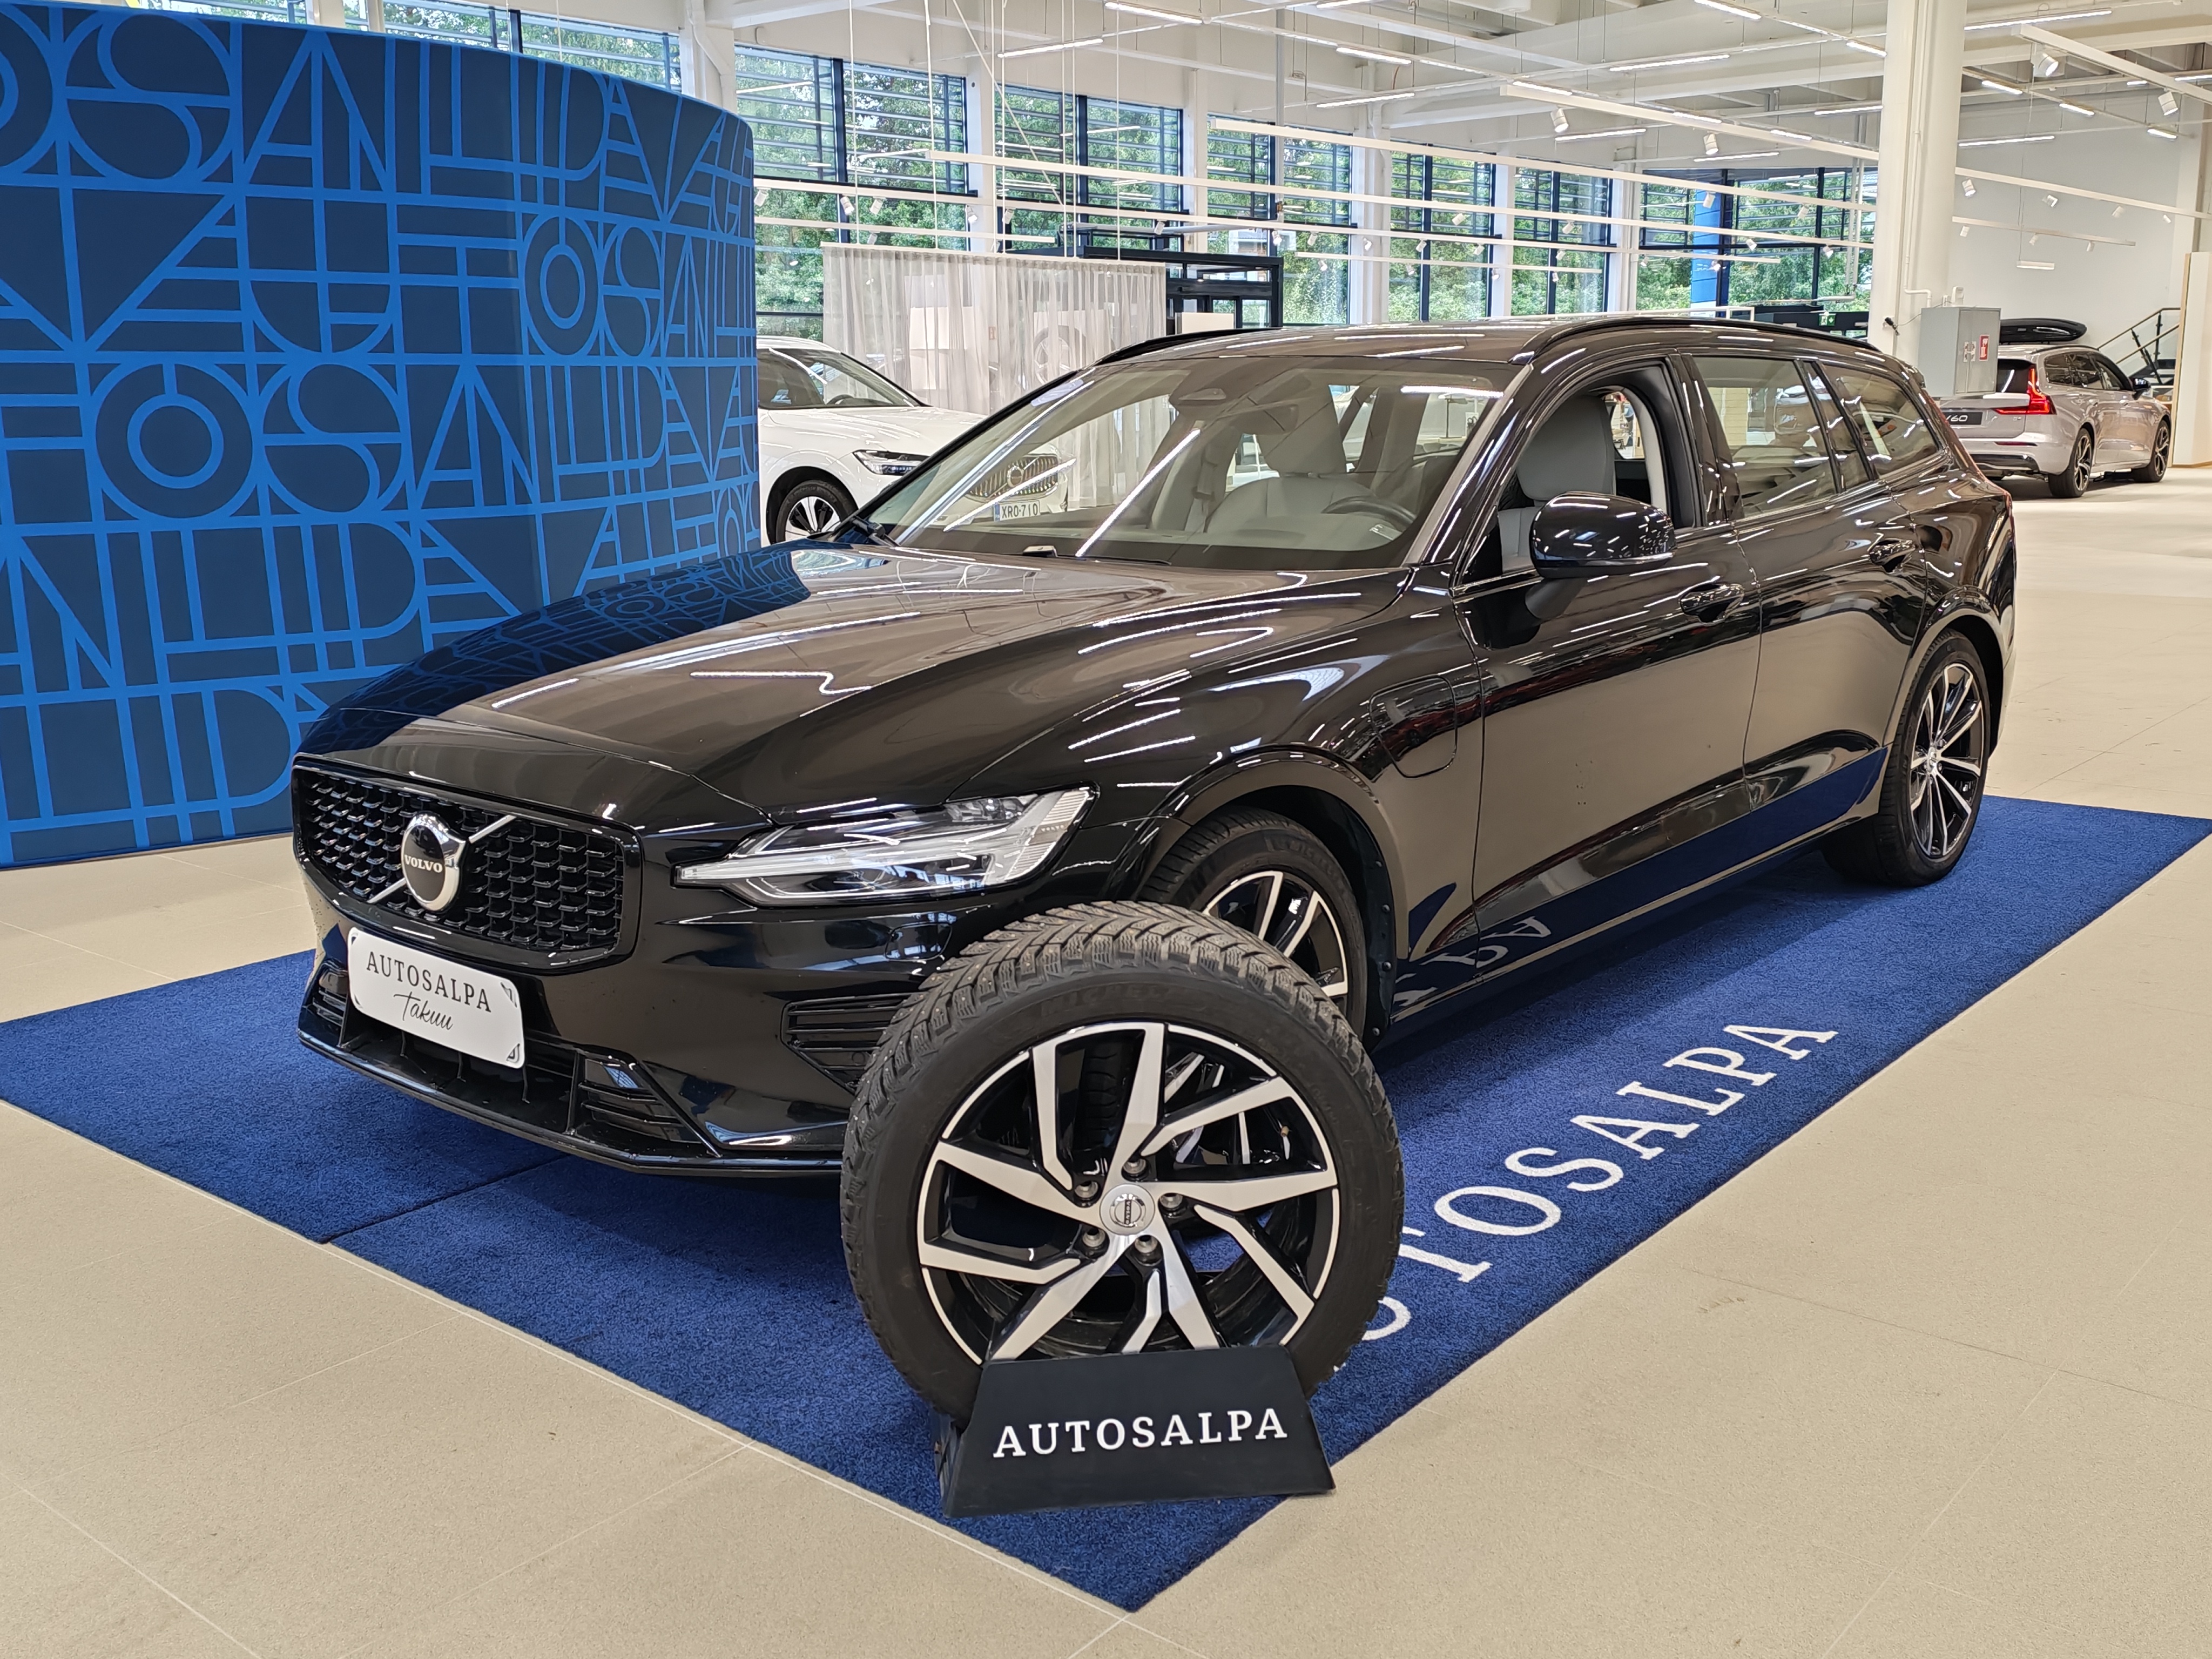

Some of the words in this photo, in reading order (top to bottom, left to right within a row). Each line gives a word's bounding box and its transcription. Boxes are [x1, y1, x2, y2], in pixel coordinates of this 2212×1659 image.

[404, 854, 443, 873] VOLVO
[366, 951, 491, 1013] AUTOSALPA
[393, 991, 454, 1030] Takuu
[1333, 1024, 1838, 1372] TOSALPA
[993, 1408, 1288, 1458] AUTOSALPA
